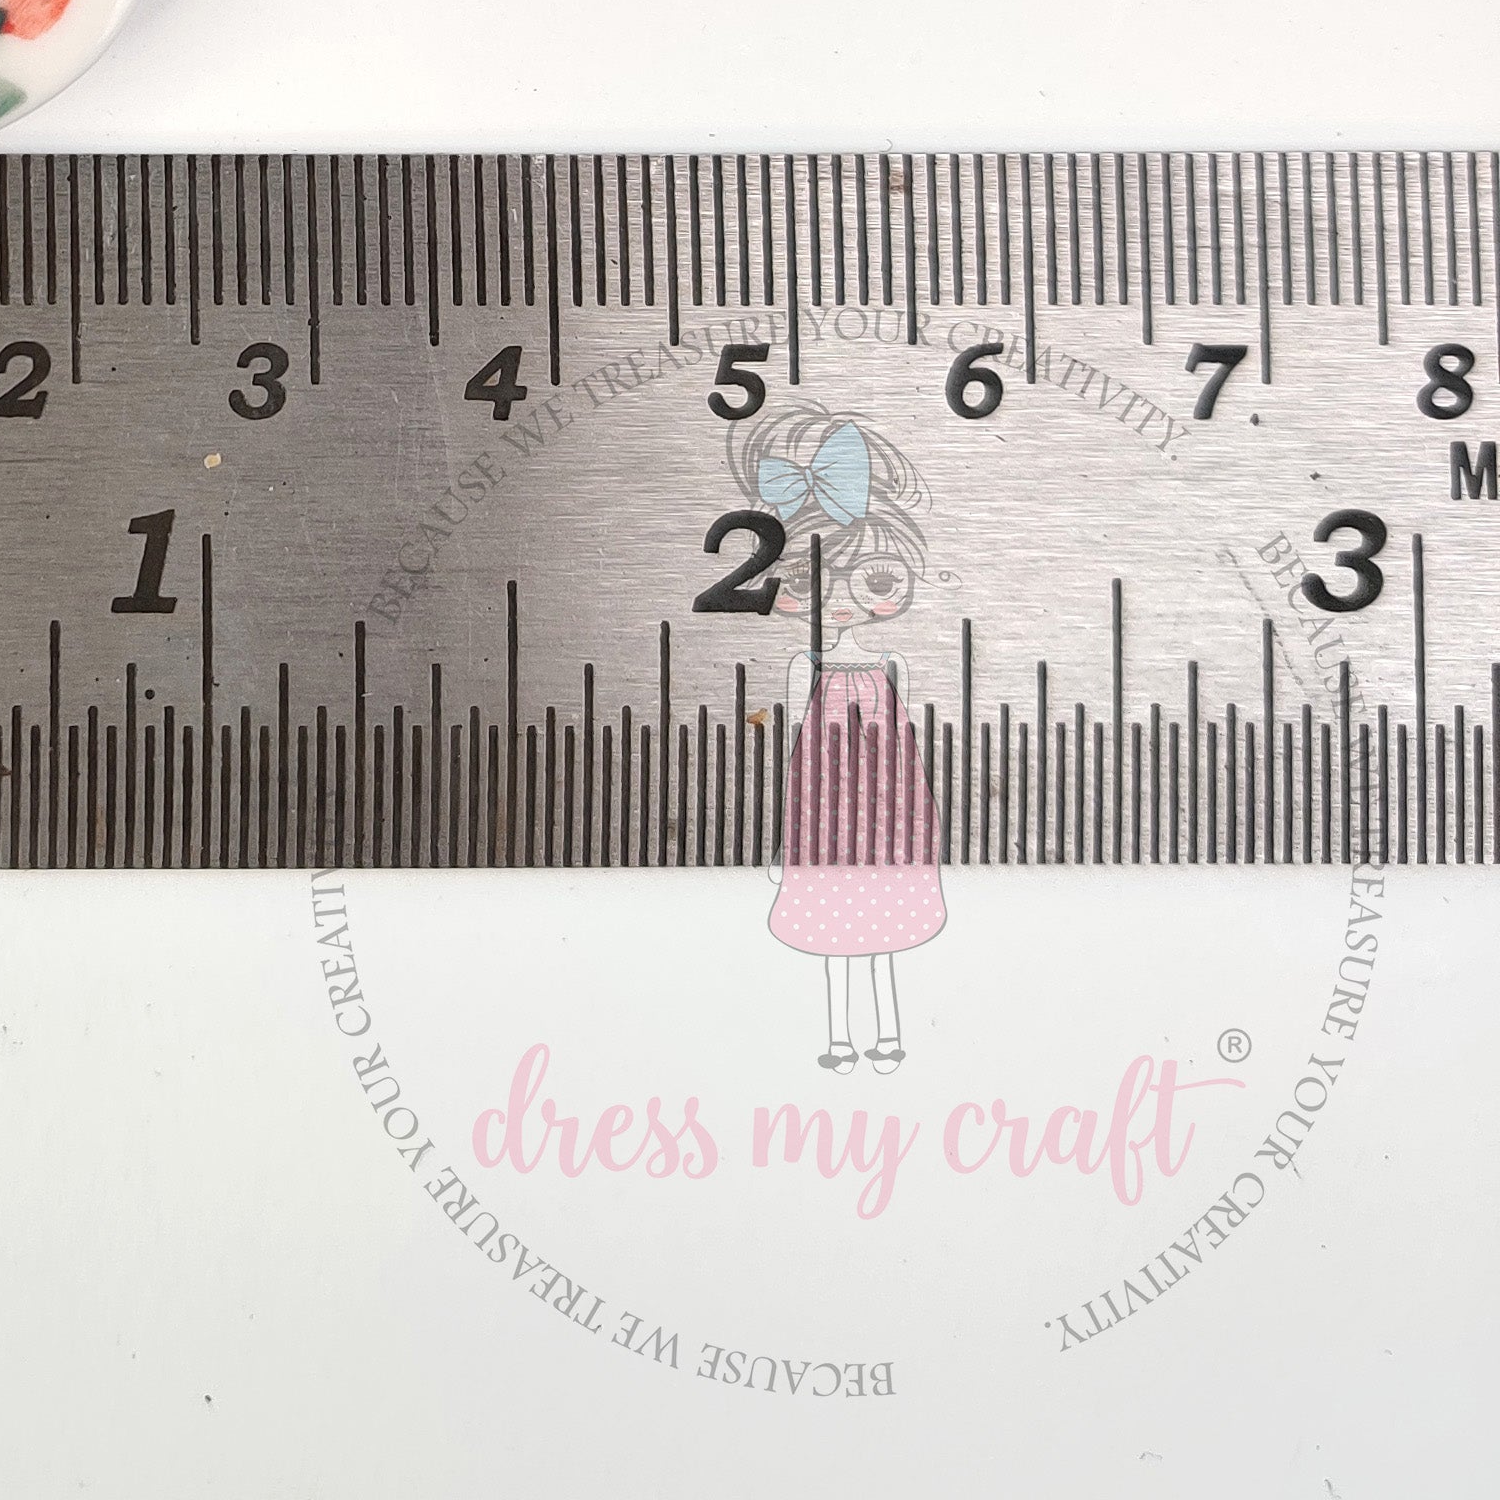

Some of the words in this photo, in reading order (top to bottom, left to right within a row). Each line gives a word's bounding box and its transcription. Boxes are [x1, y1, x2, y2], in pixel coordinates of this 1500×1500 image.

[229, 343, 289, 420] 3
[465, 346, 527, 421] 4
[709, 344, 770, 420] 5
[945, 343, 1003, 419] 6
[1184, 345, 1247, 419] 7
[1416, 344, 1475, 419] 8
[111, 509, 177, 613] 1
[692, 511, 786, 615] 2
[1302, 511, 1387, 612] 3
